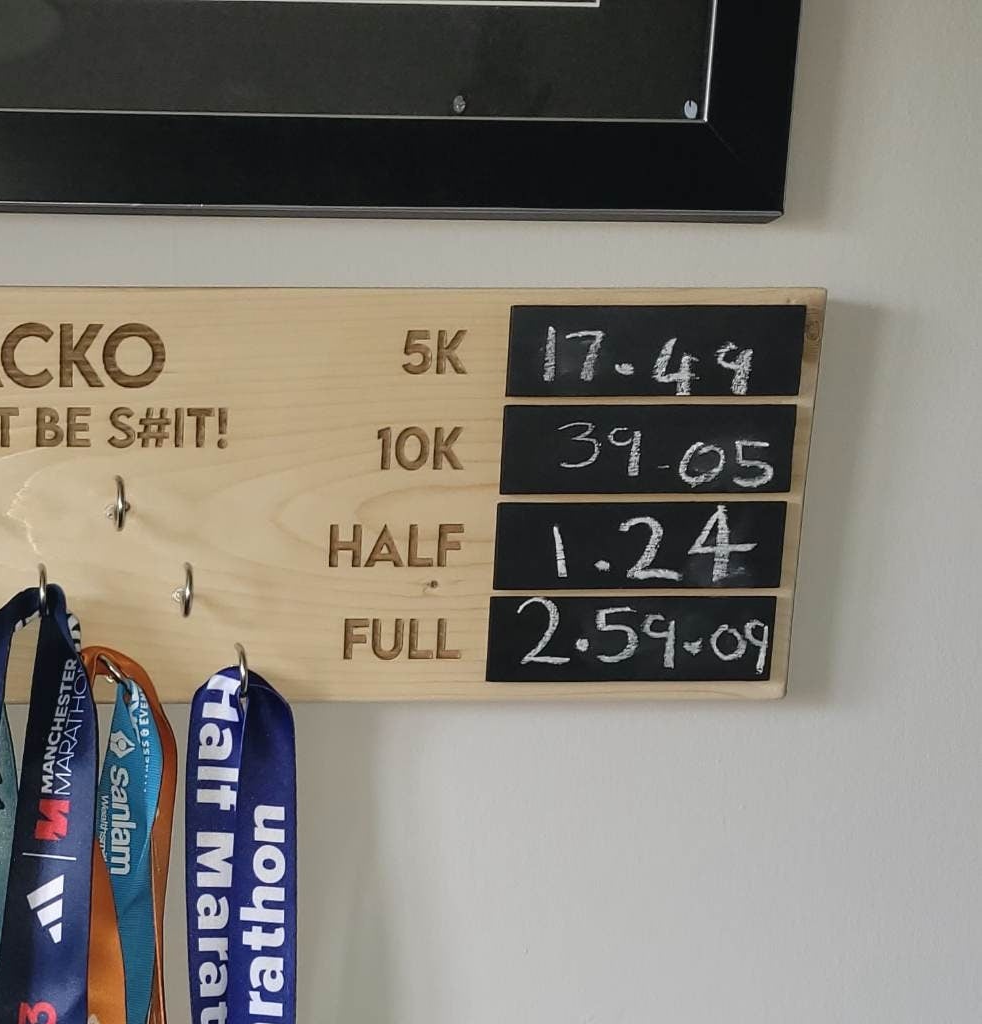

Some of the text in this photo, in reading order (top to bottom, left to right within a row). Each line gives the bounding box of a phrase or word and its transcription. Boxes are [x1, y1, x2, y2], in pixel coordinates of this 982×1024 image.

[401, 329, 467, 375] 5K
[541, 325, 754, 396] 17.49
[35, 406, 92, 448] BE
[107, 406, 230, 449] S#IT!
[377, 426, 464, 471] 10K
[328, 524, 465, 568] HALF
[552, 504, 758, 582] 1.24
[343, 618, 462, 660] FULL
[517, 596, 770, 675] 2.59.09
[41, 658, 78, 794] MANCHESTER
[110, 765, 137, 876] sanlam
